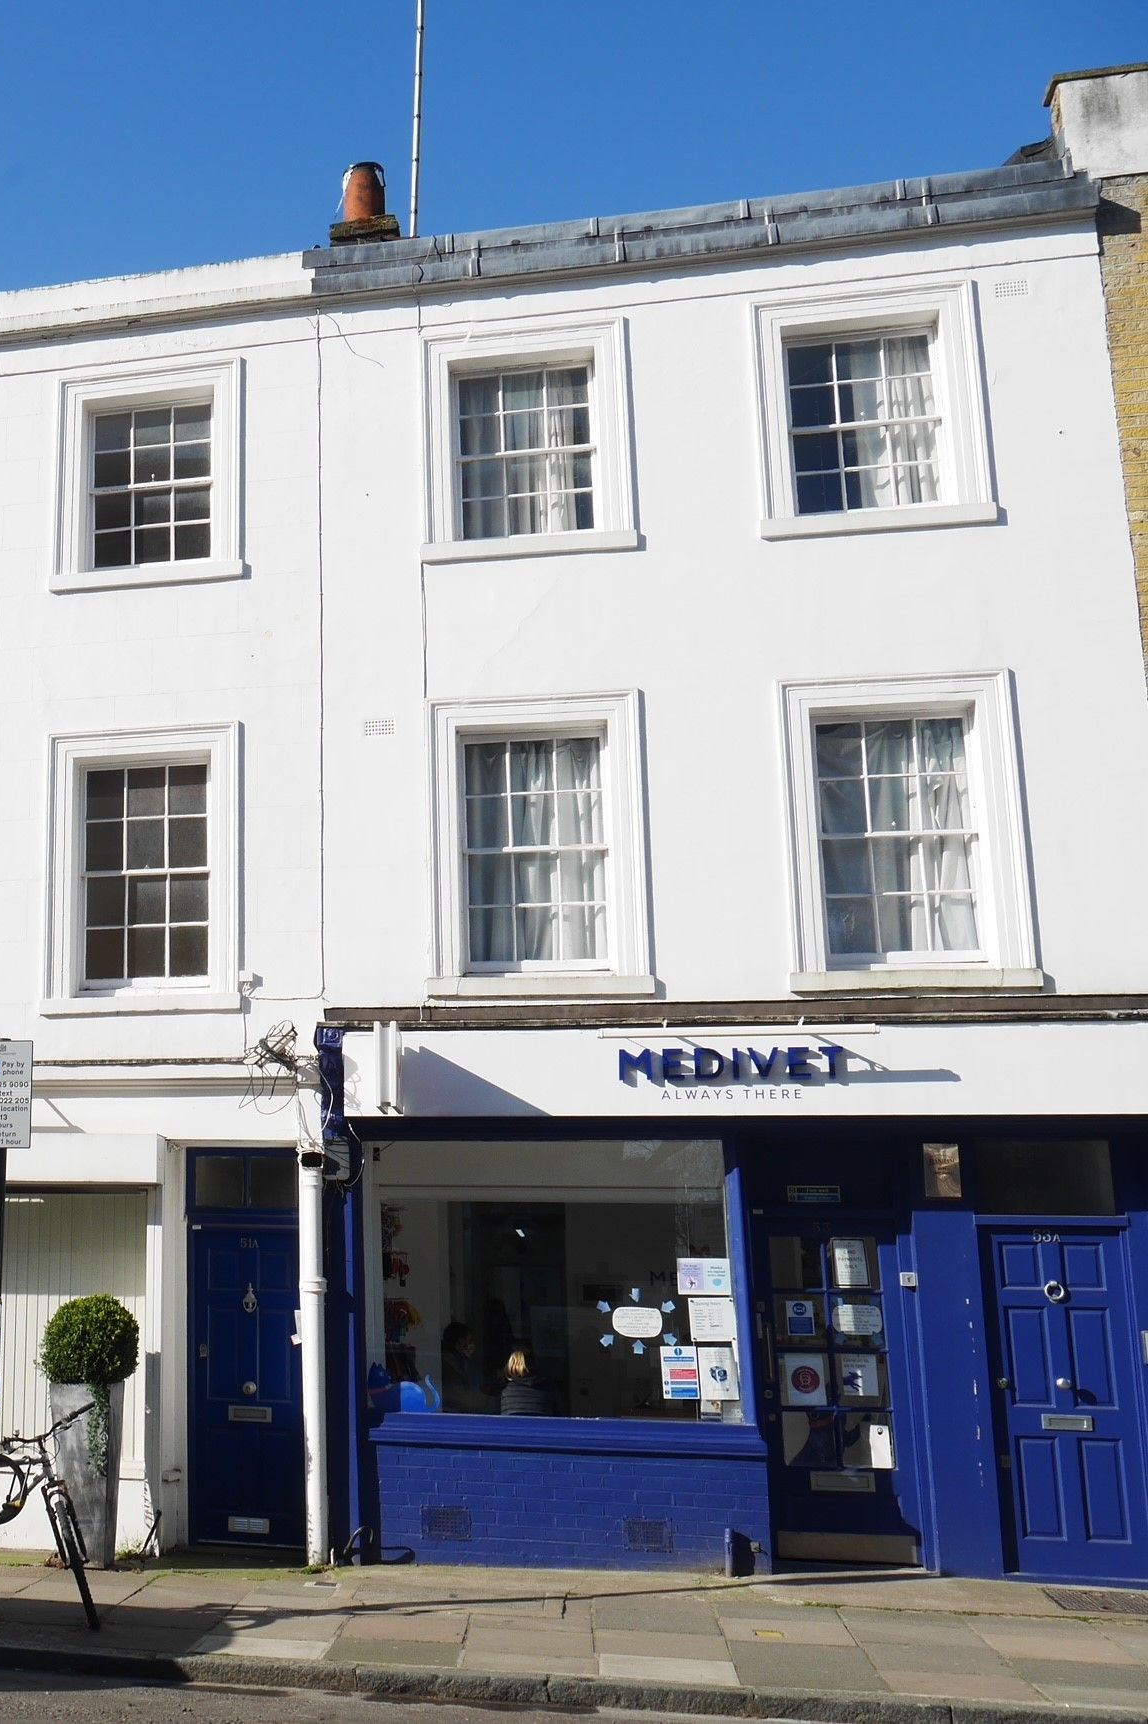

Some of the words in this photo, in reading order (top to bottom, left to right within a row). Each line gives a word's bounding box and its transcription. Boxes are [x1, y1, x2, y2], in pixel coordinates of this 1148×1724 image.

[618, 1046, 844, 1081] MEDIVET
[661, 1089, 733, 1100] ALWAYS
[743, 1088, 803, 1100] THERE
[240, 1237, 260, 1248] 51A
